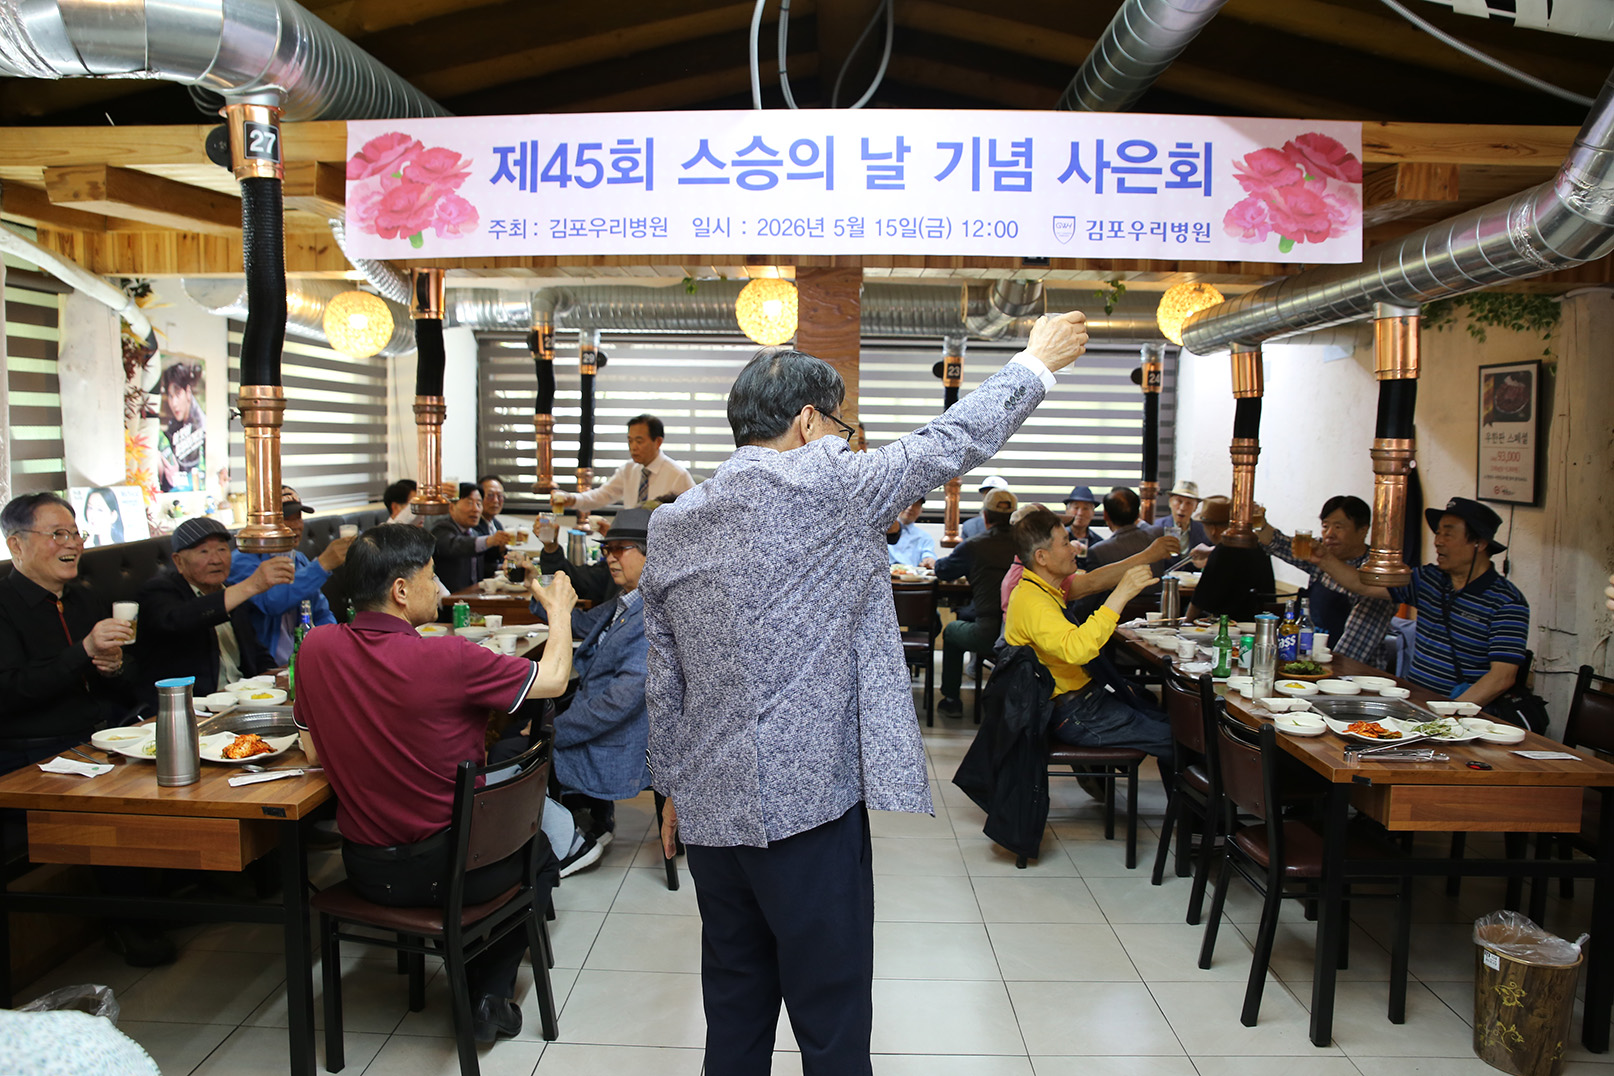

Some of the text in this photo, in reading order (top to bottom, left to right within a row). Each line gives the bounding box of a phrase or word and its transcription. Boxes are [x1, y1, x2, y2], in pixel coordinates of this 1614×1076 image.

[249, 129, 277, 155] 27
[490, 135, 1213, 197] 제45회 스승의 날 기념 사은회
[549, 216, 668, 239] 김포우리병원
[692, 216, 731, 238] 일시
[757, 217, 825, 238] 2026년
[833, 216, 865, 239] 5월
[875, 216, 952, 240] 15일(금)
[962, 219, 1019, 239] 12:00
[1086, 219, 1212, 244] 김포우리병원
[948, 365, 960, 377] 23
[1149, 372, 1161, 384] 24
[1278, 634, 1297, 649] ass
